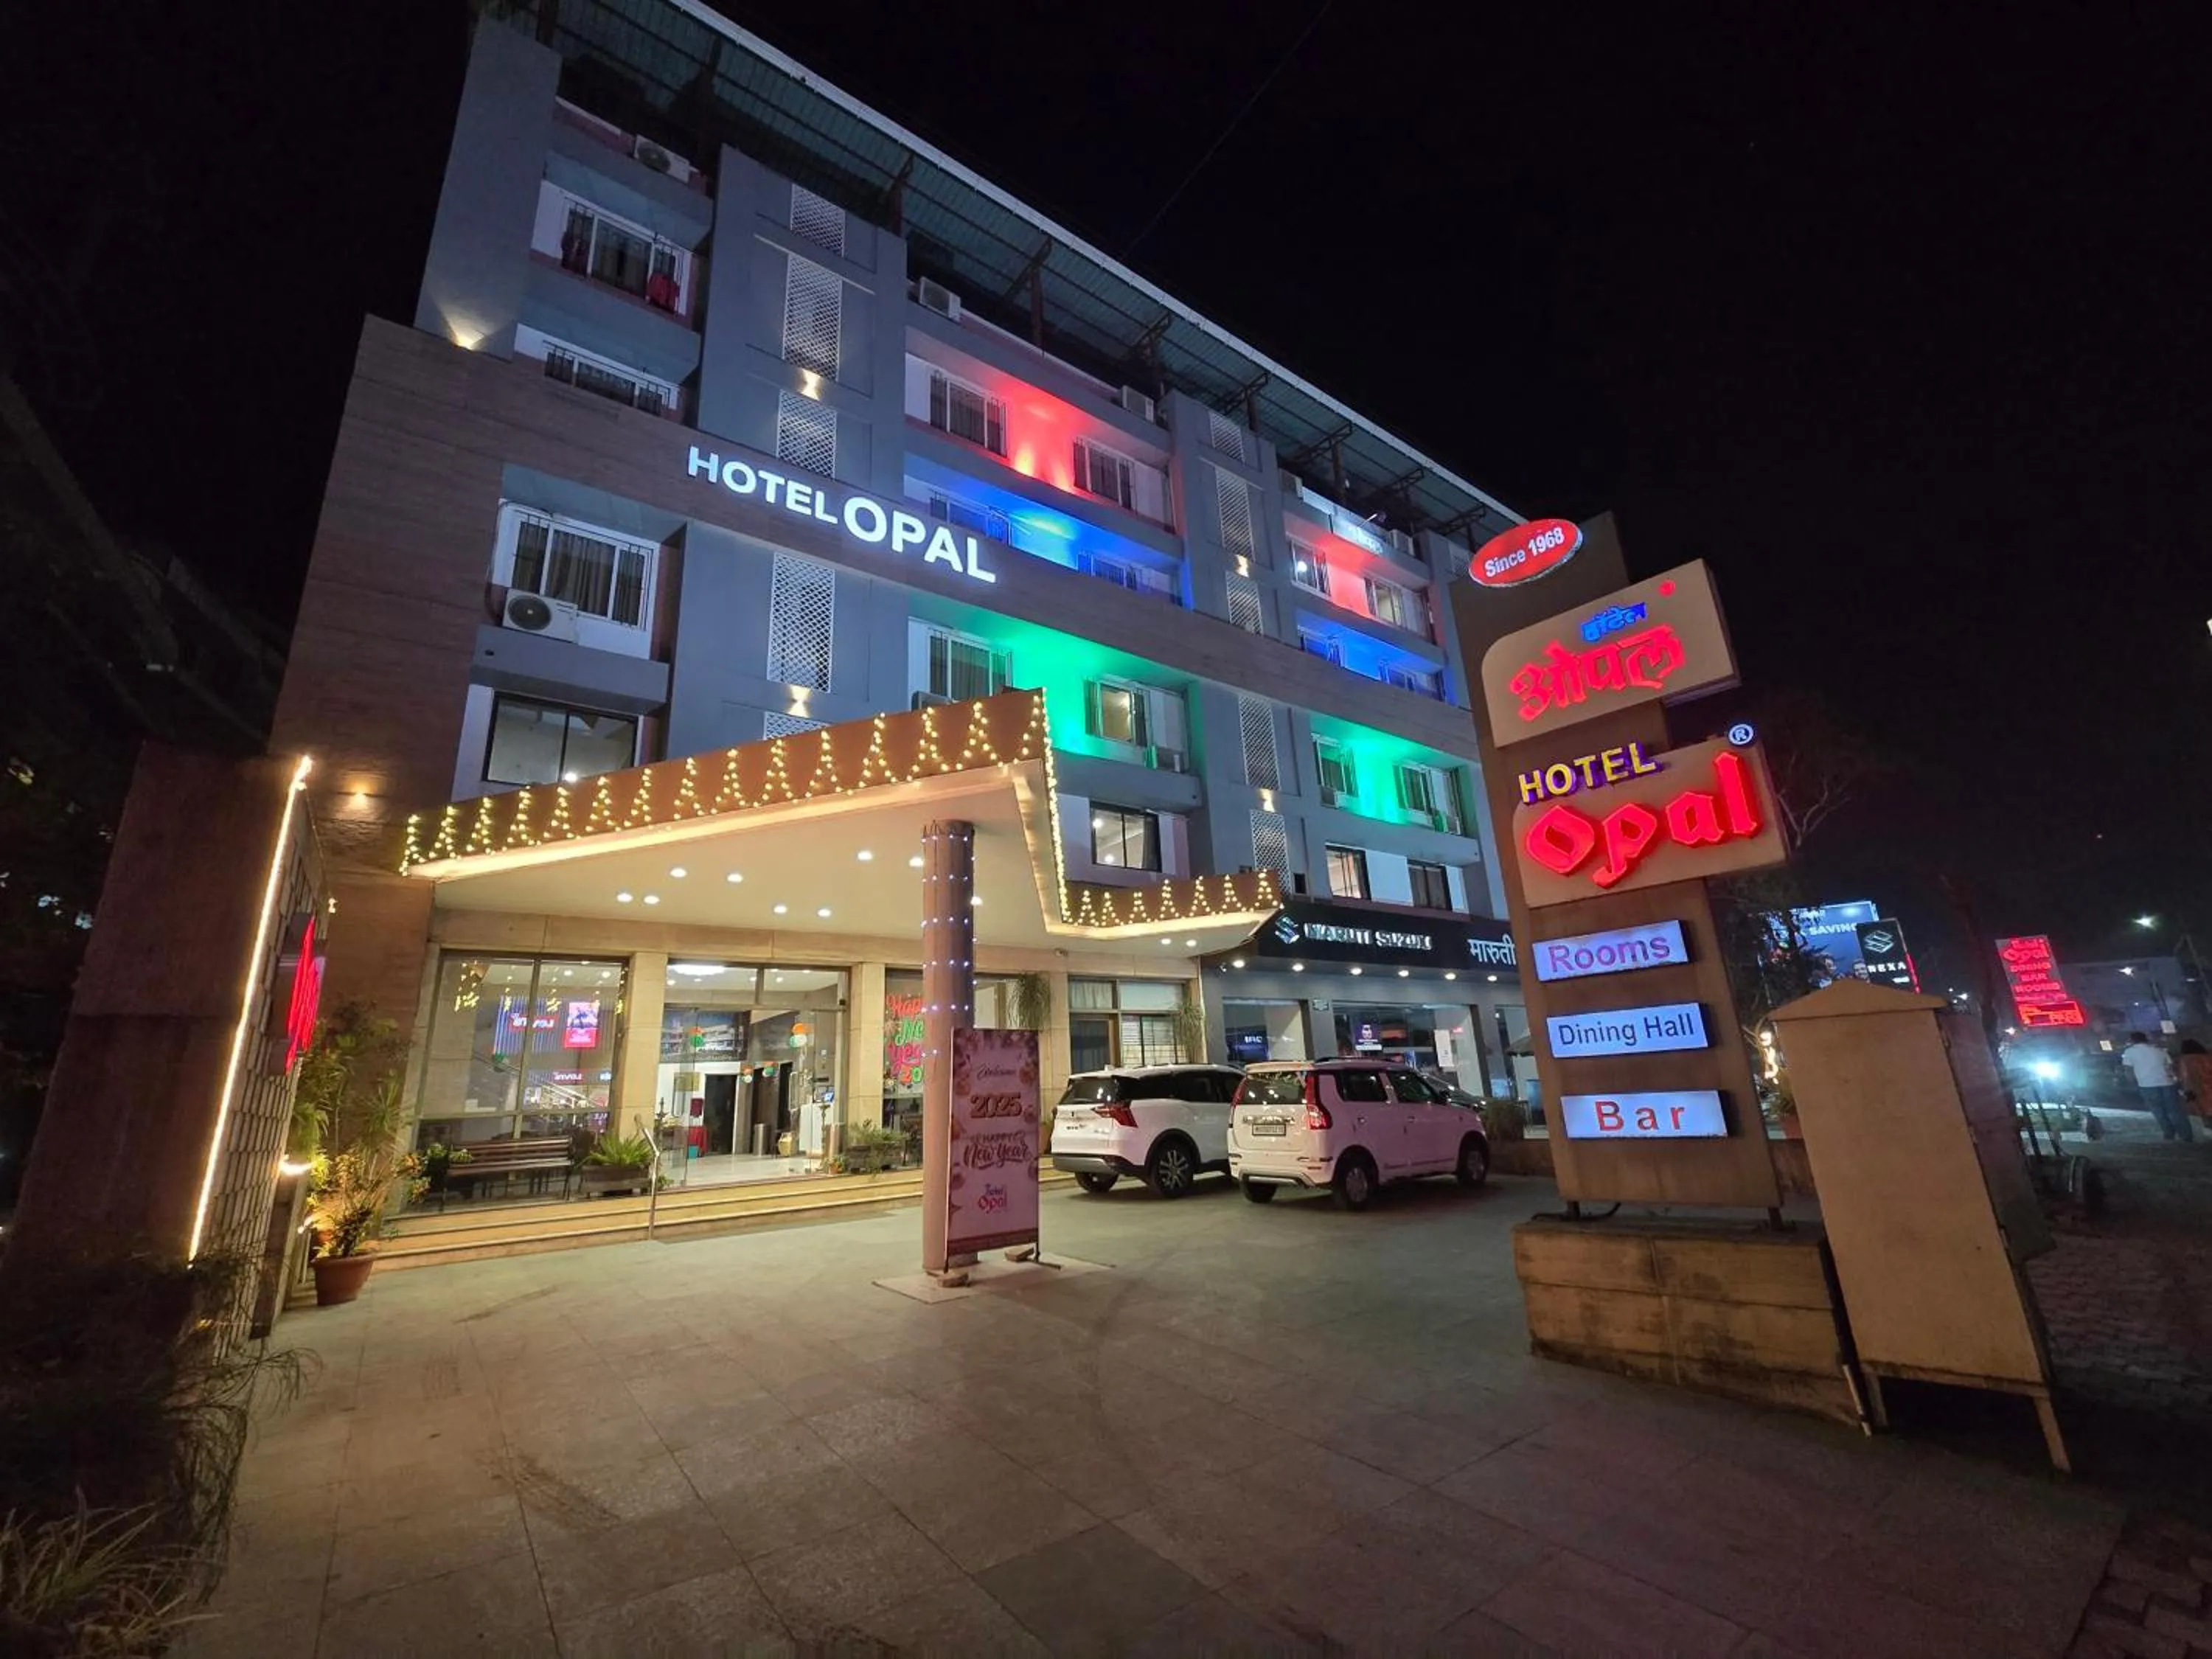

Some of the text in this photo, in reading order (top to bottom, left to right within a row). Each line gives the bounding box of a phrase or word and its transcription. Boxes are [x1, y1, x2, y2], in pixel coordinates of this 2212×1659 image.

[687, 445, 997, 583] HOTEL OPAL
[1484, 526, 1565, 577] Since 1968
[1510, 623, 1686, 722] ओपल
[1518, 742, 1659, 804] HOTEL
[1526, 751, 1759, 888] Opal
[1467, 933, 1517, 965] मारुती
[1548, 936, 1670, 973] Rooms
[1867, 961, 1907, 973] NEXA
[1558, 1013, 1694, 1046] Dining Hall
[970, 1093, 1022, 1119] 2025
[1595, 1101, 1685, 1131] Bar
